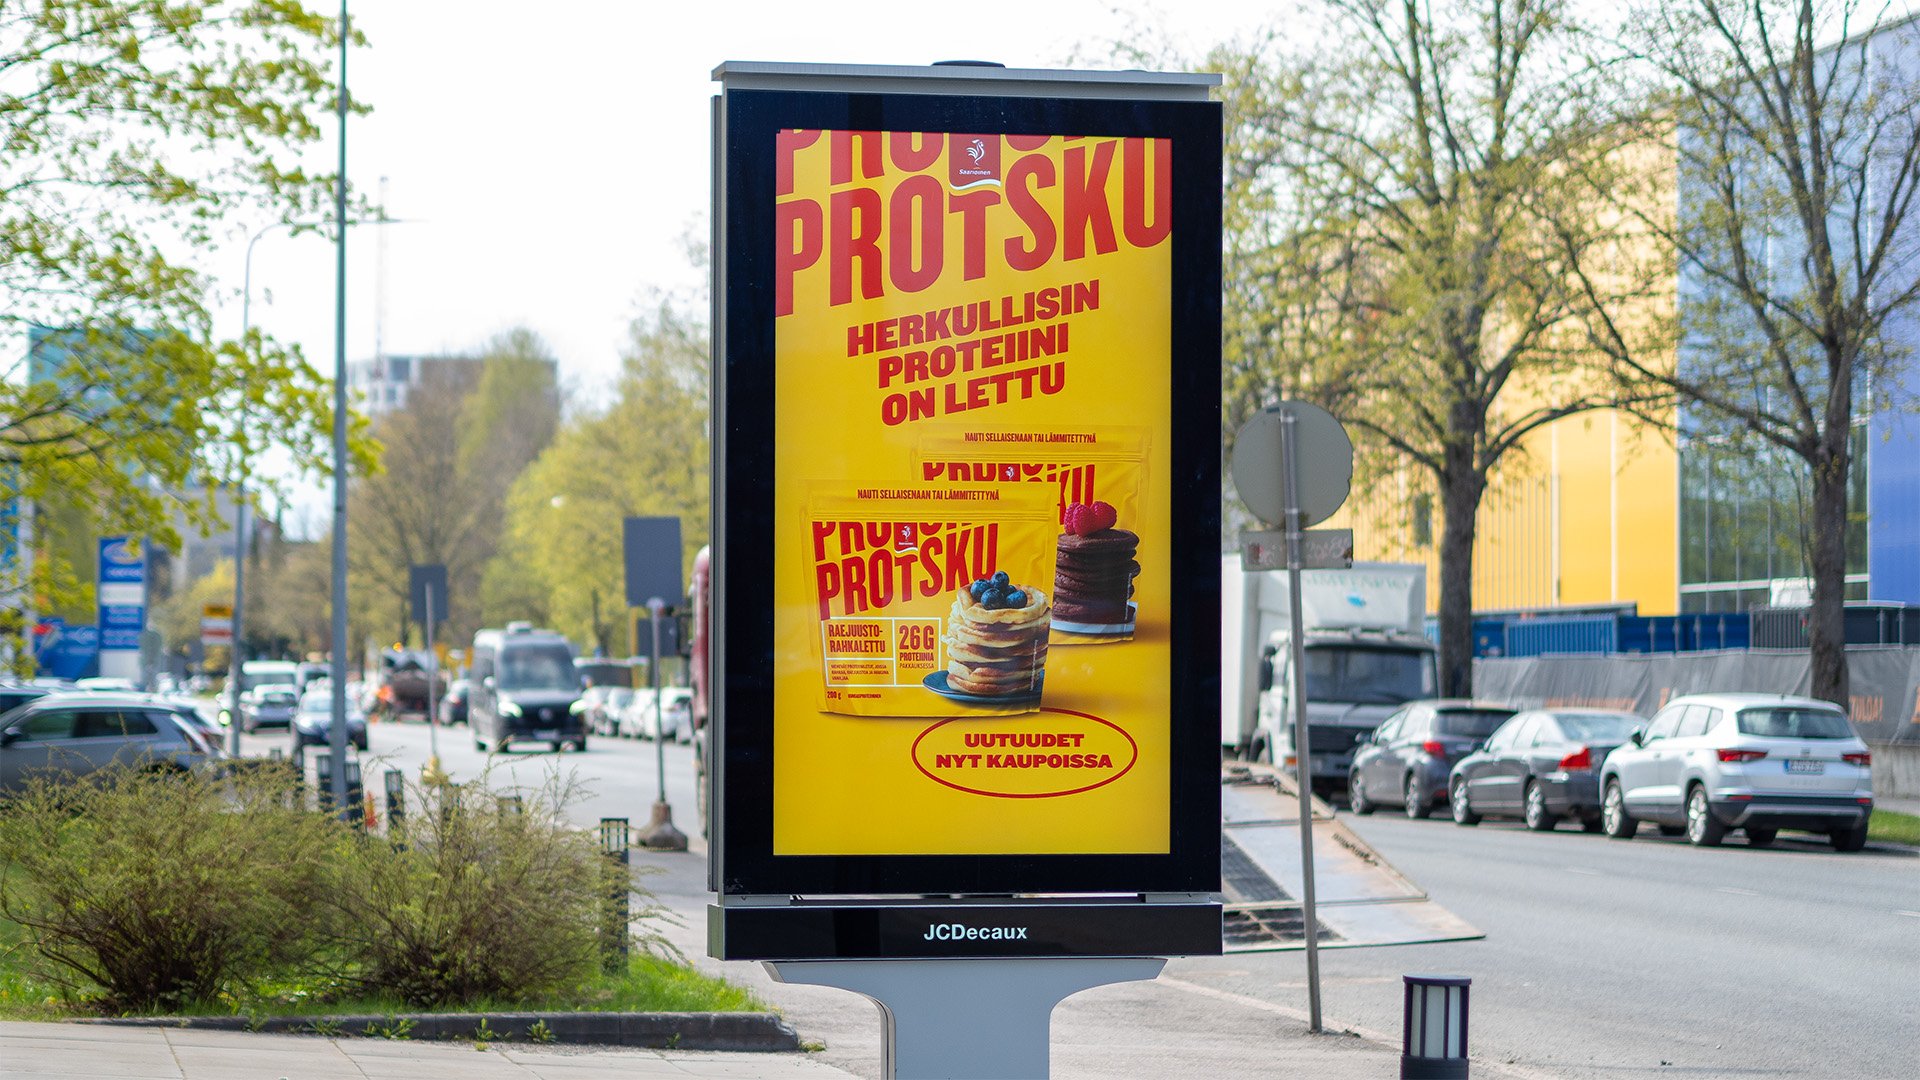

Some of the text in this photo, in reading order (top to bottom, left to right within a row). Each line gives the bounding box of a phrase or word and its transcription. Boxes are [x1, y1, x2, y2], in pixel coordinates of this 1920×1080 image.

[775, 137, 1172, 317] PROTSKU
[847, 279, 1099, 357] HERKULLISIN
[878, 322, 1068, 388] PROTEIINI
[881, 362, 1065, 426] ON LETTU
[965, 431, 1096, 443] NAUTI SELLAISENAAN TAI LÄMMITETTYNÄ
[858, 488, 999, 501] NAUTI SELLAISENAAN TAI LÄMMITETTYNÄ
[816, 523, 998, 621] PROTSKU
[828, 624, 883, 638] RAEJUUSTO-
[899, 625, 934, 650] 26 G
[830, 640, 885, 653] RAHKALETTU
[964, 733, 1085, 748] UUTUUDET
[935, 754, 1113, 769] NYT KAUPOISSA
[923, 924, 1028, 941] JCDecaux
